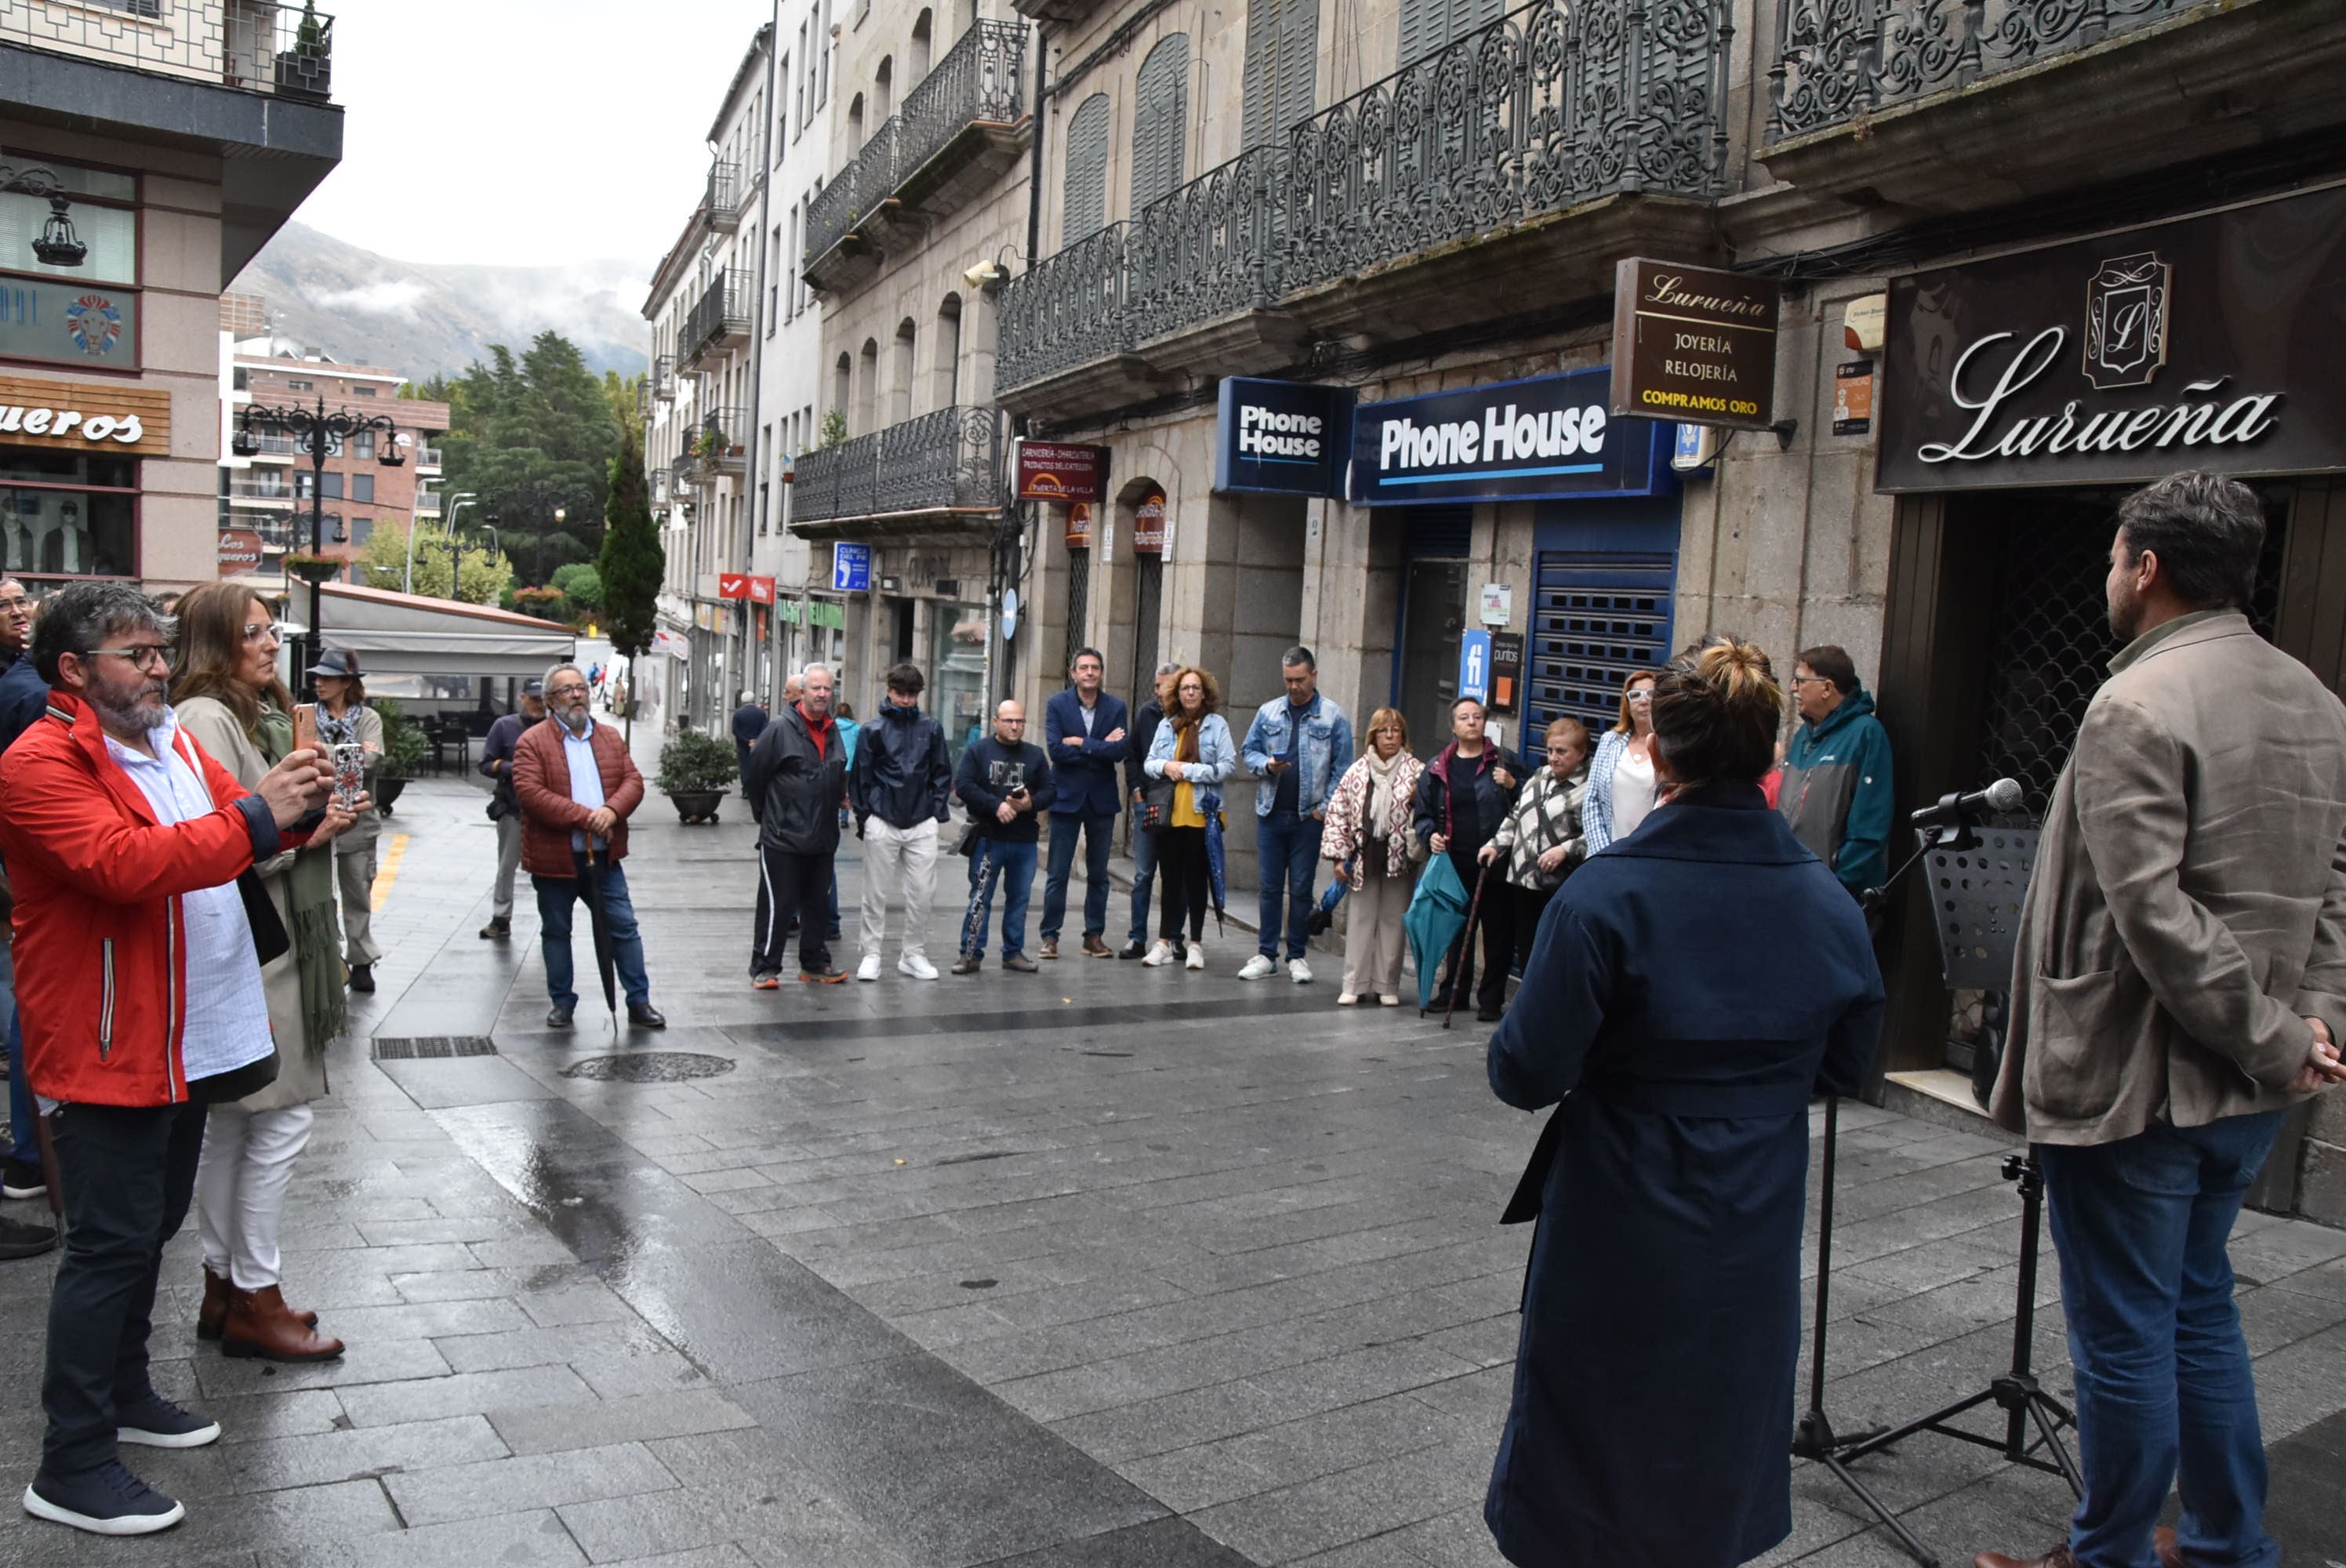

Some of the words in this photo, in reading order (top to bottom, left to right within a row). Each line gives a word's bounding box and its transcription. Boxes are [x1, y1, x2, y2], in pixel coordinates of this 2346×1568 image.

[1645, 275, 1766, 316] Lurueña
[2106, 302, 2146, 353] L
[1675, 333, 1731, 354] JOYERÍA
[1665, 360, 1738, 382] RELOJERÍA
[1643, 390, 1727, 411] COMPRAMOS
[1730, 400, 1757, 415] ORO
[1918, 326, 2280, 463] Lurueña
[1240, 405, 1322, 434] Phone
[1240, 428, 1320, 457] House
[1380, 418, 1480, 470] Phone
[1483, 404, 1606, 462] House
[1033, 484, 1057, 492] PUERTA
[217, 533, 244, 549] Los
[1494, 649, 1518, 663] puntos
